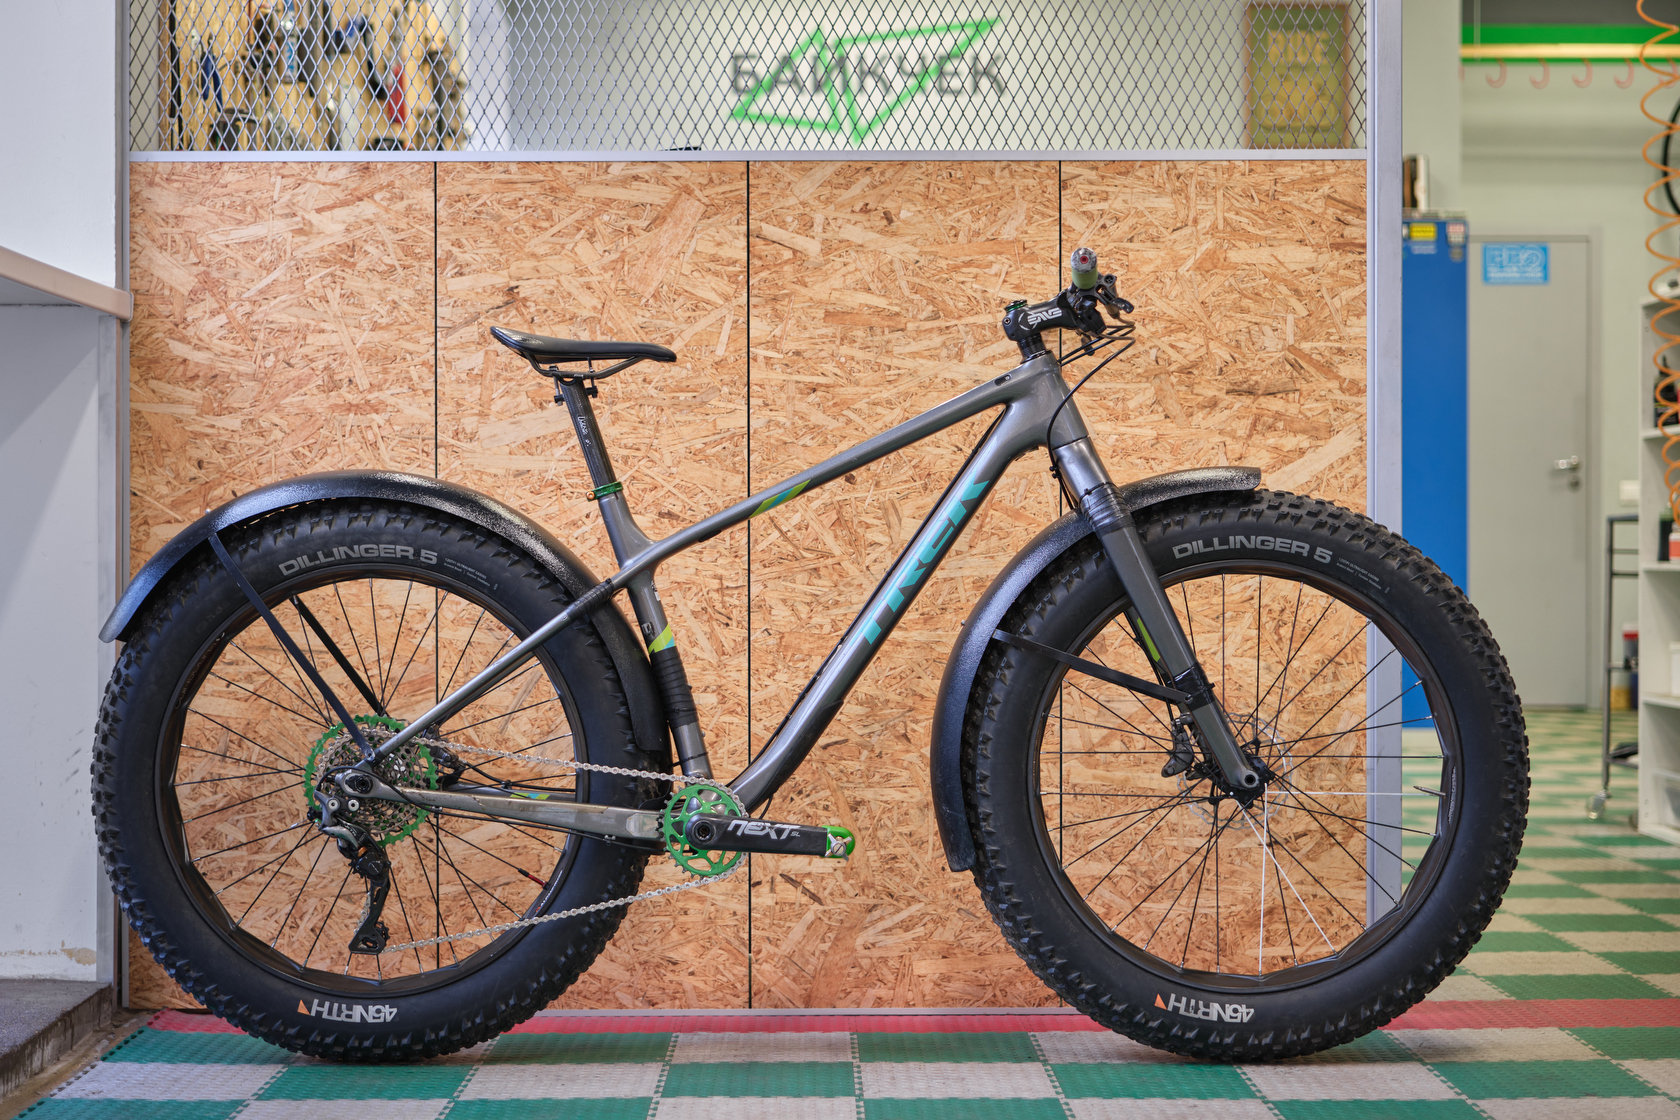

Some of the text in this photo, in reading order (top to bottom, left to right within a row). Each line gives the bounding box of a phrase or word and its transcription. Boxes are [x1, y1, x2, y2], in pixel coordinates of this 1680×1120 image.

[732, 46, 1006, 98] БАЙКЧЕК
[278, 543, 414, 576] DILLINGER
[419, 549, 438, 565] 5
[850, 470, 989, 645] TREK
[1172, 535, 1333, 564] DILLINGER 5
[310, 998, 398, 1023] 45NRTH
[1167, 993, 1255, 1023] 45NRTH
